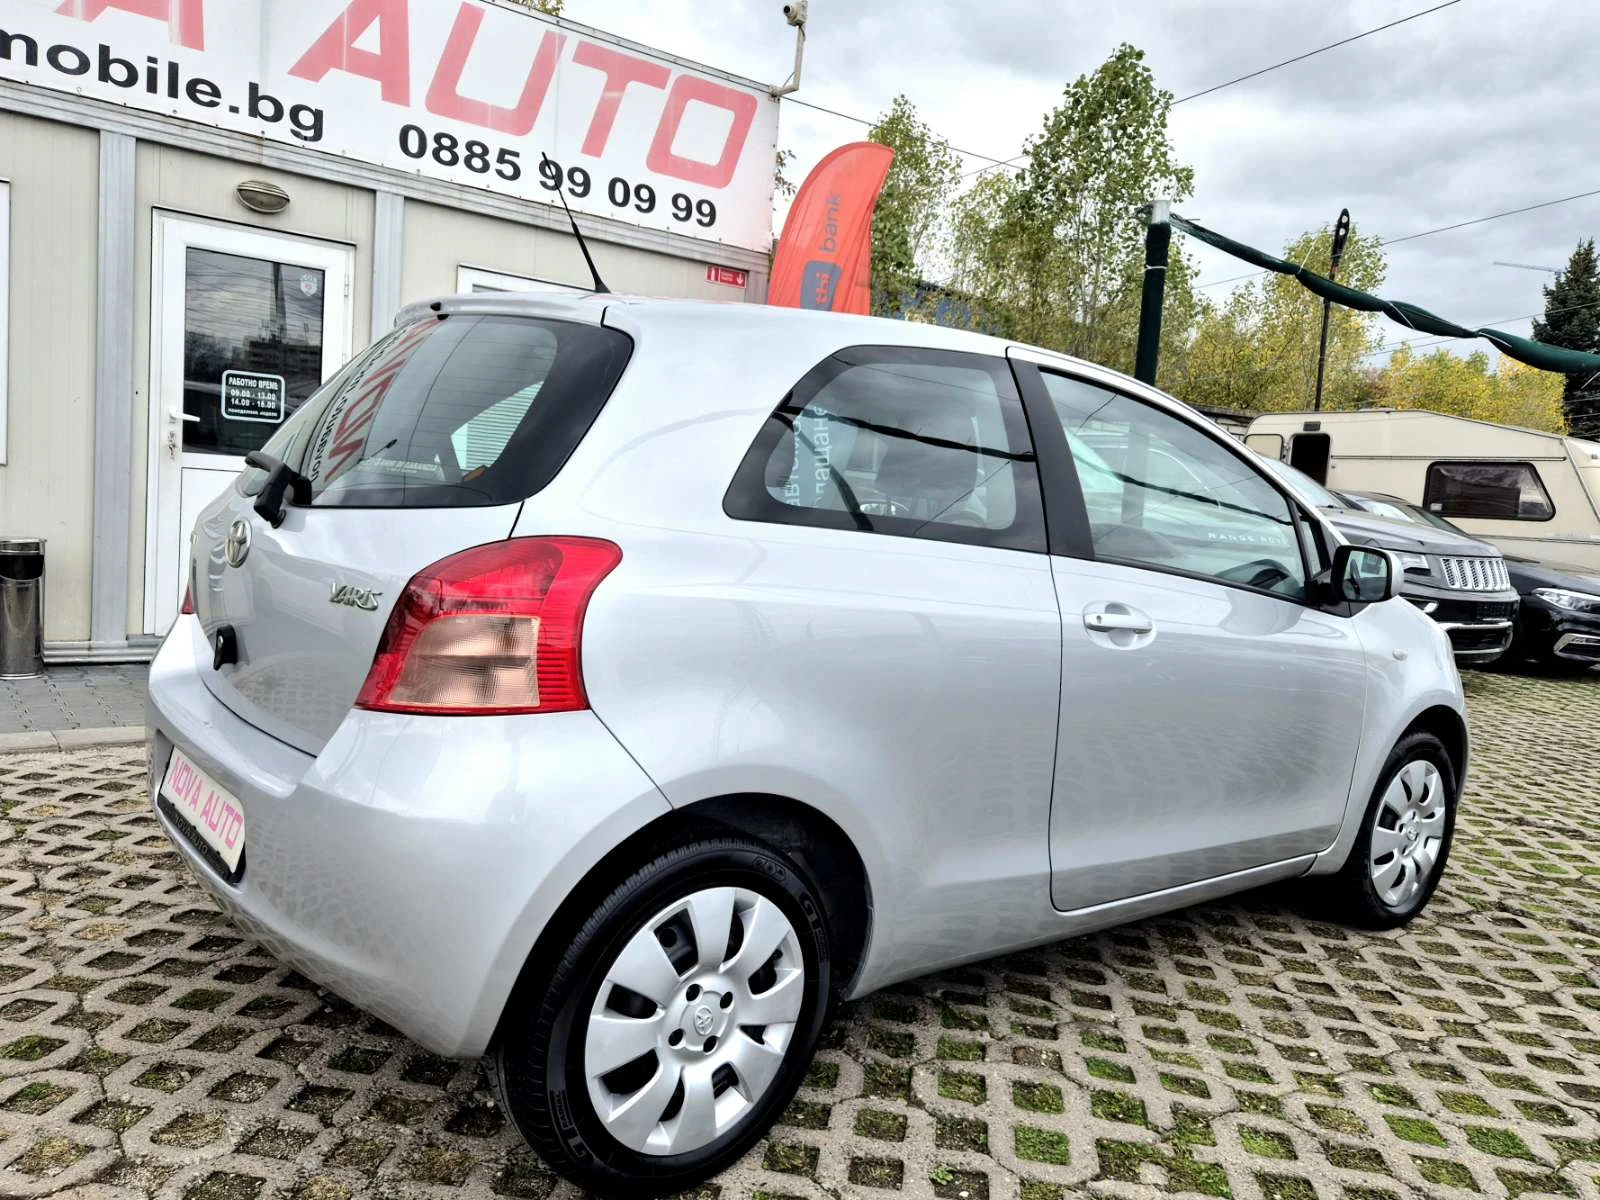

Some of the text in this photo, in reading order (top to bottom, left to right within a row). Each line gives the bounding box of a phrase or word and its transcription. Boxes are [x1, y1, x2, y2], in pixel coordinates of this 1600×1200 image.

[288, 0, 758, 190] AUTO
[399, 123, 717, 227] 0885 99 09 99
[820, 192, 843, 253] bank
[168, 756, 244, 850] NOVA AUTO
